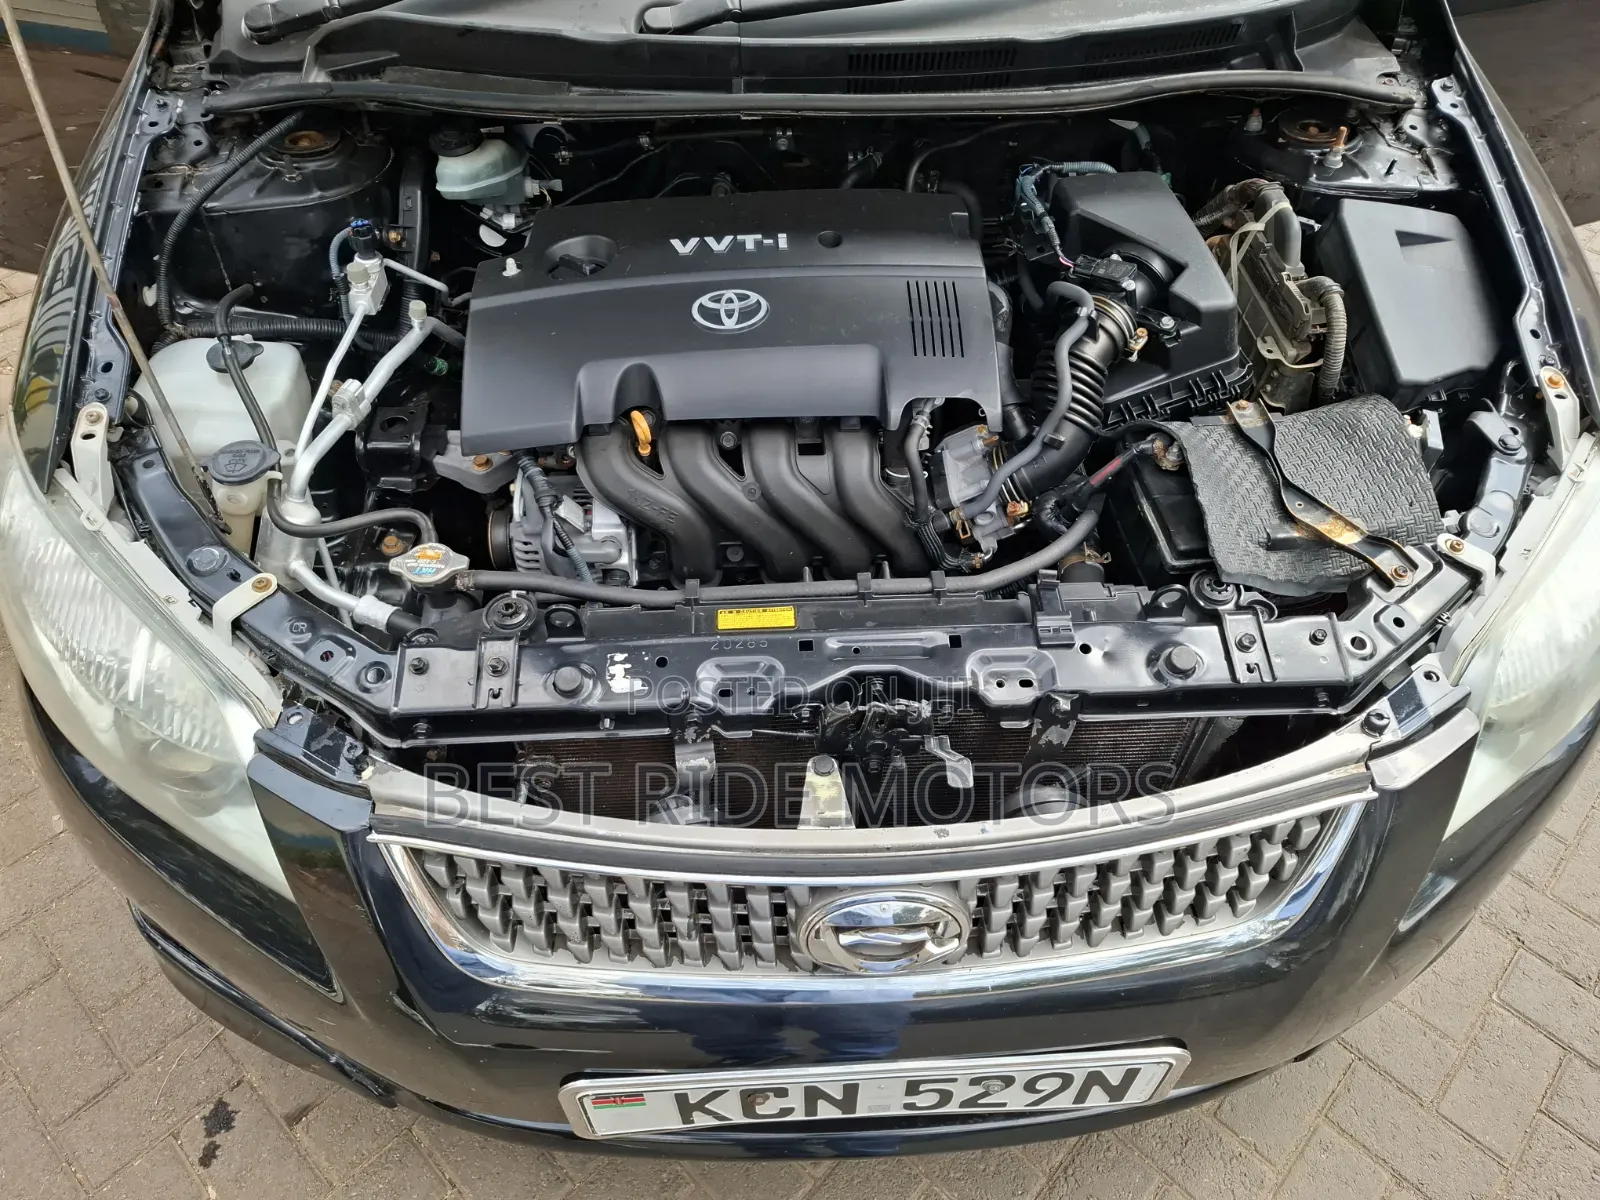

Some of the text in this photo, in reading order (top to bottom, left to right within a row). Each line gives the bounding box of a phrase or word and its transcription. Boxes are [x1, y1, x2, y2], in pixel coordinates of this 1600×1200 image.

[669, 233, 788, 255] VVT-i
[673, 1082, 860, 1125] KCN
[902, 1067, 1143, 1112] 529N
